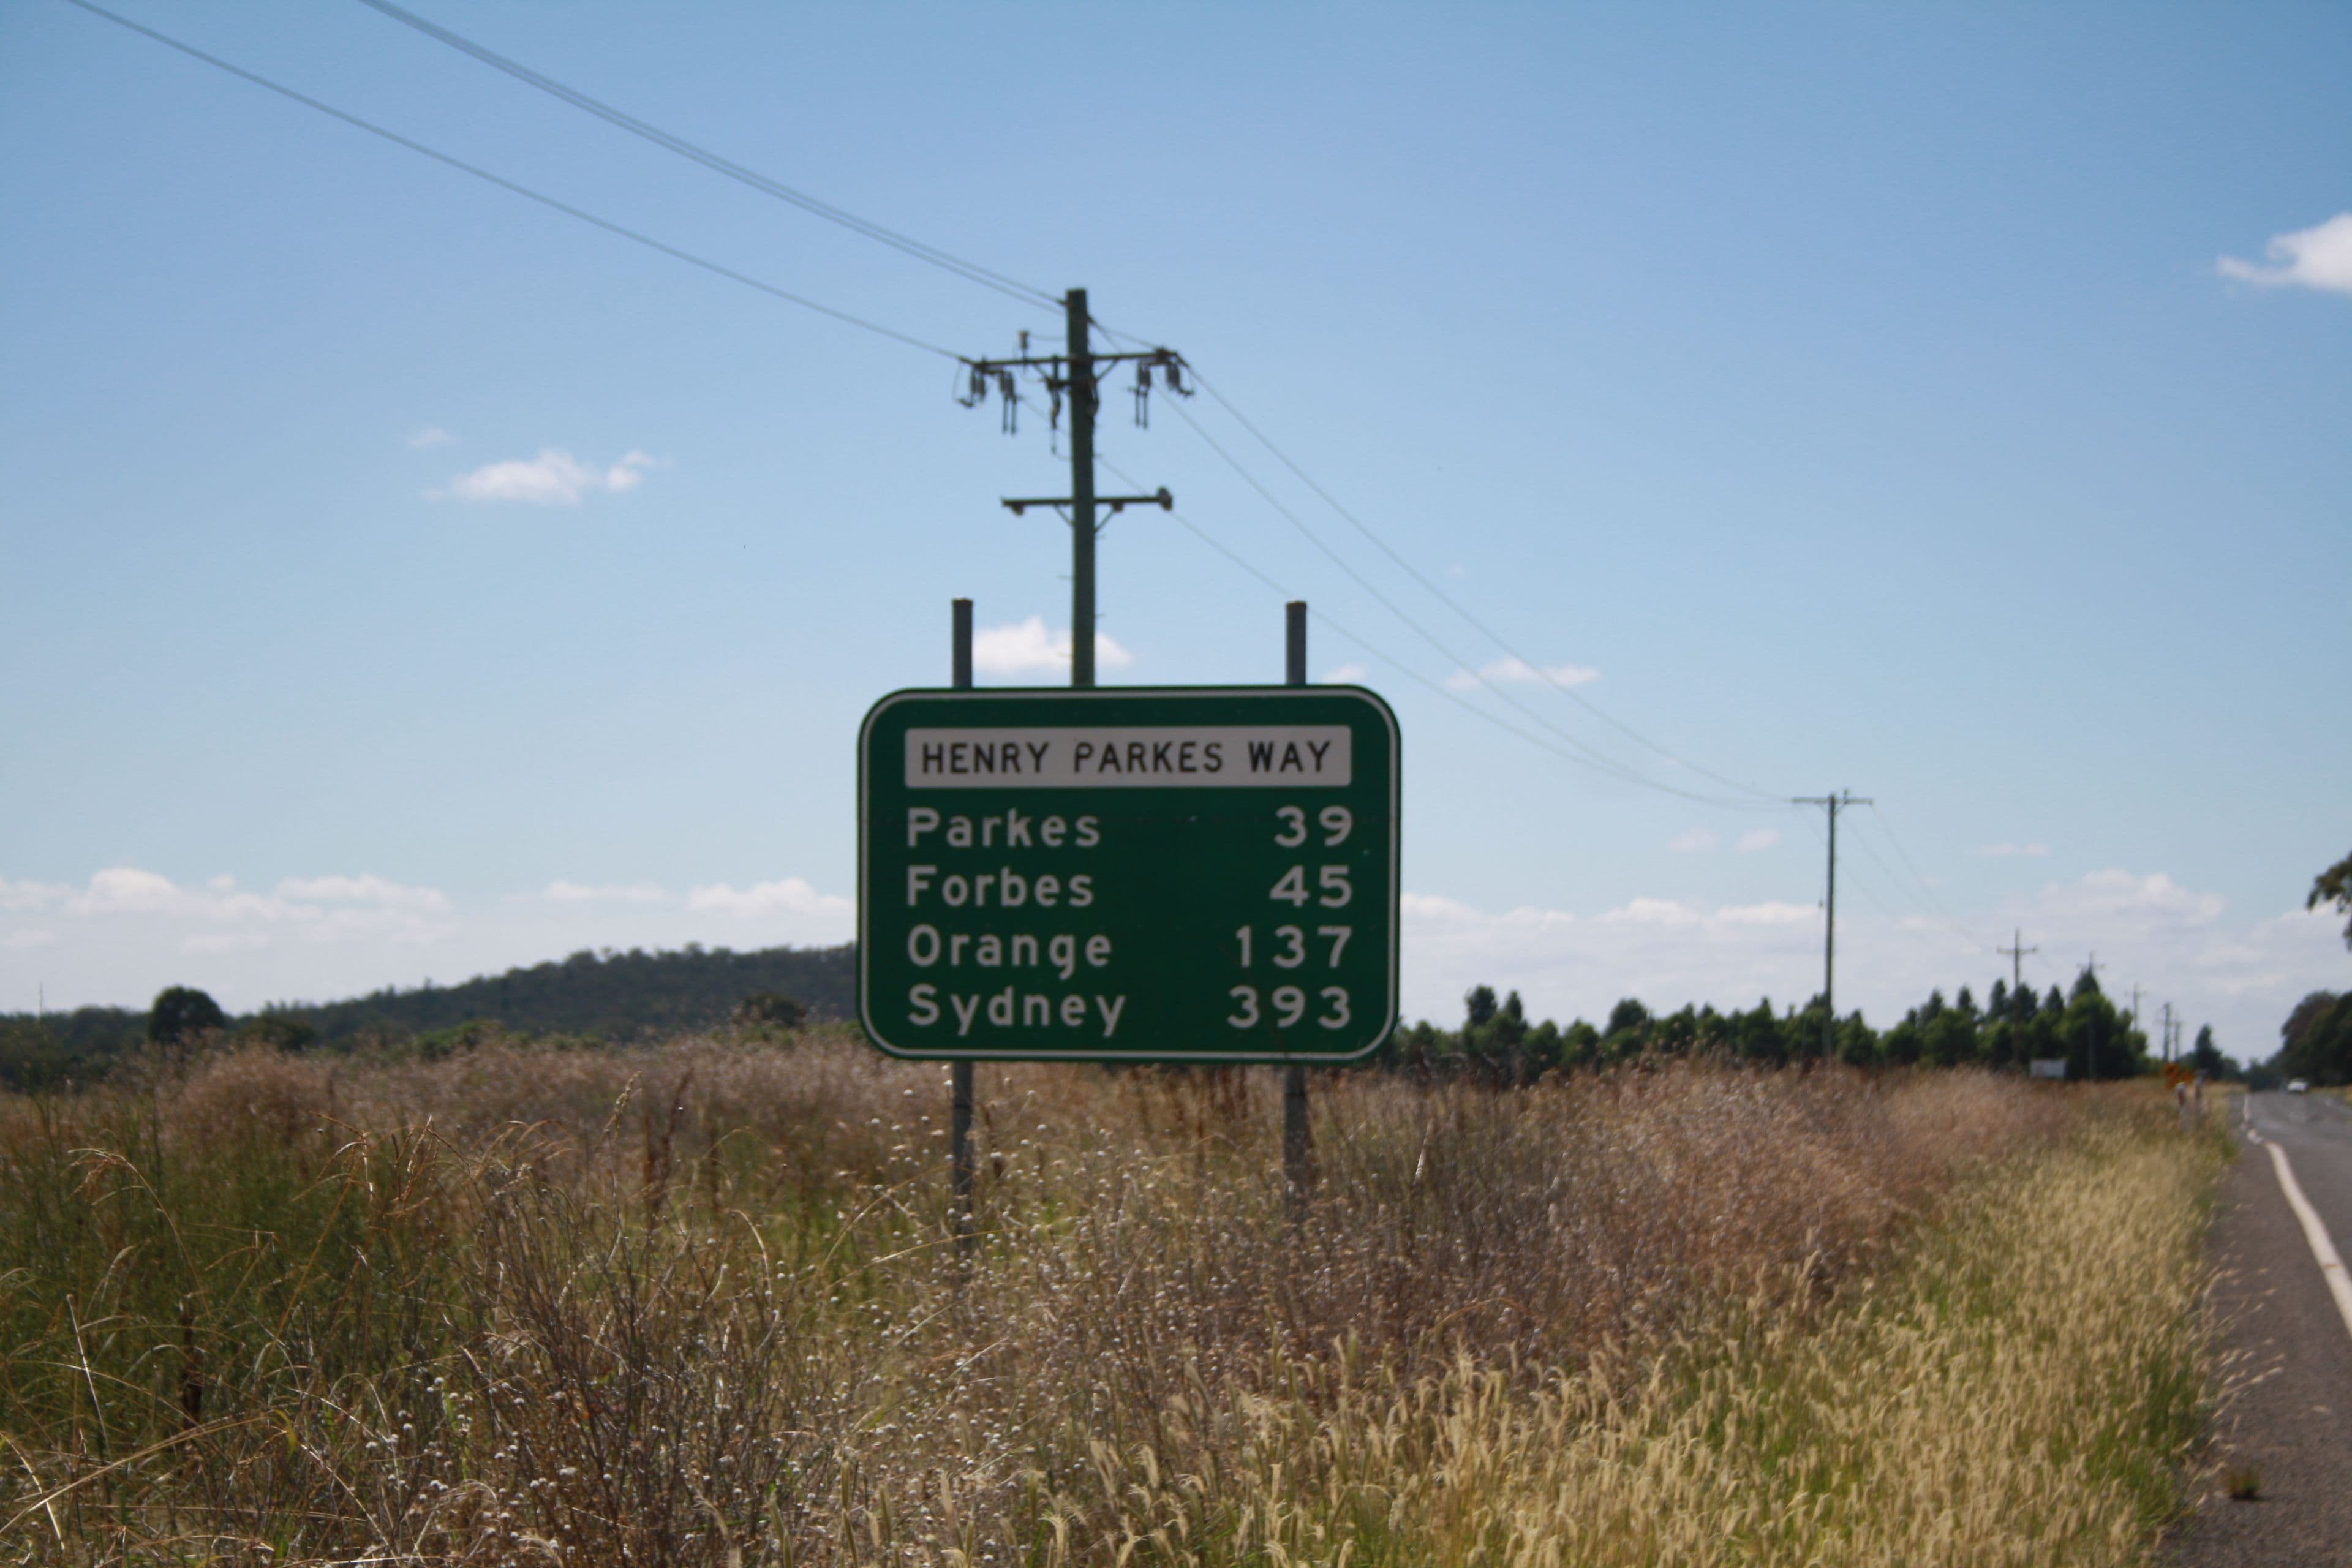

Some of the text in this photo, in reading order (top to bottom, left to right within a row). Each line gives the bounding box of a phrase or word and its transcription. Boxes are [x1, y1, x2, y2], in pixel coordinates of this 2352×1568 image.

[922, 740, 1332, 774] HENRY PARKES WAY
[907, 805, 1353, 848] Parkes 39
[907, 865, 1353, 908] Forbes 45
[907, 924, 1352, 981] Orange 137
[908, 984, 1351, 1038] Sydney 393
